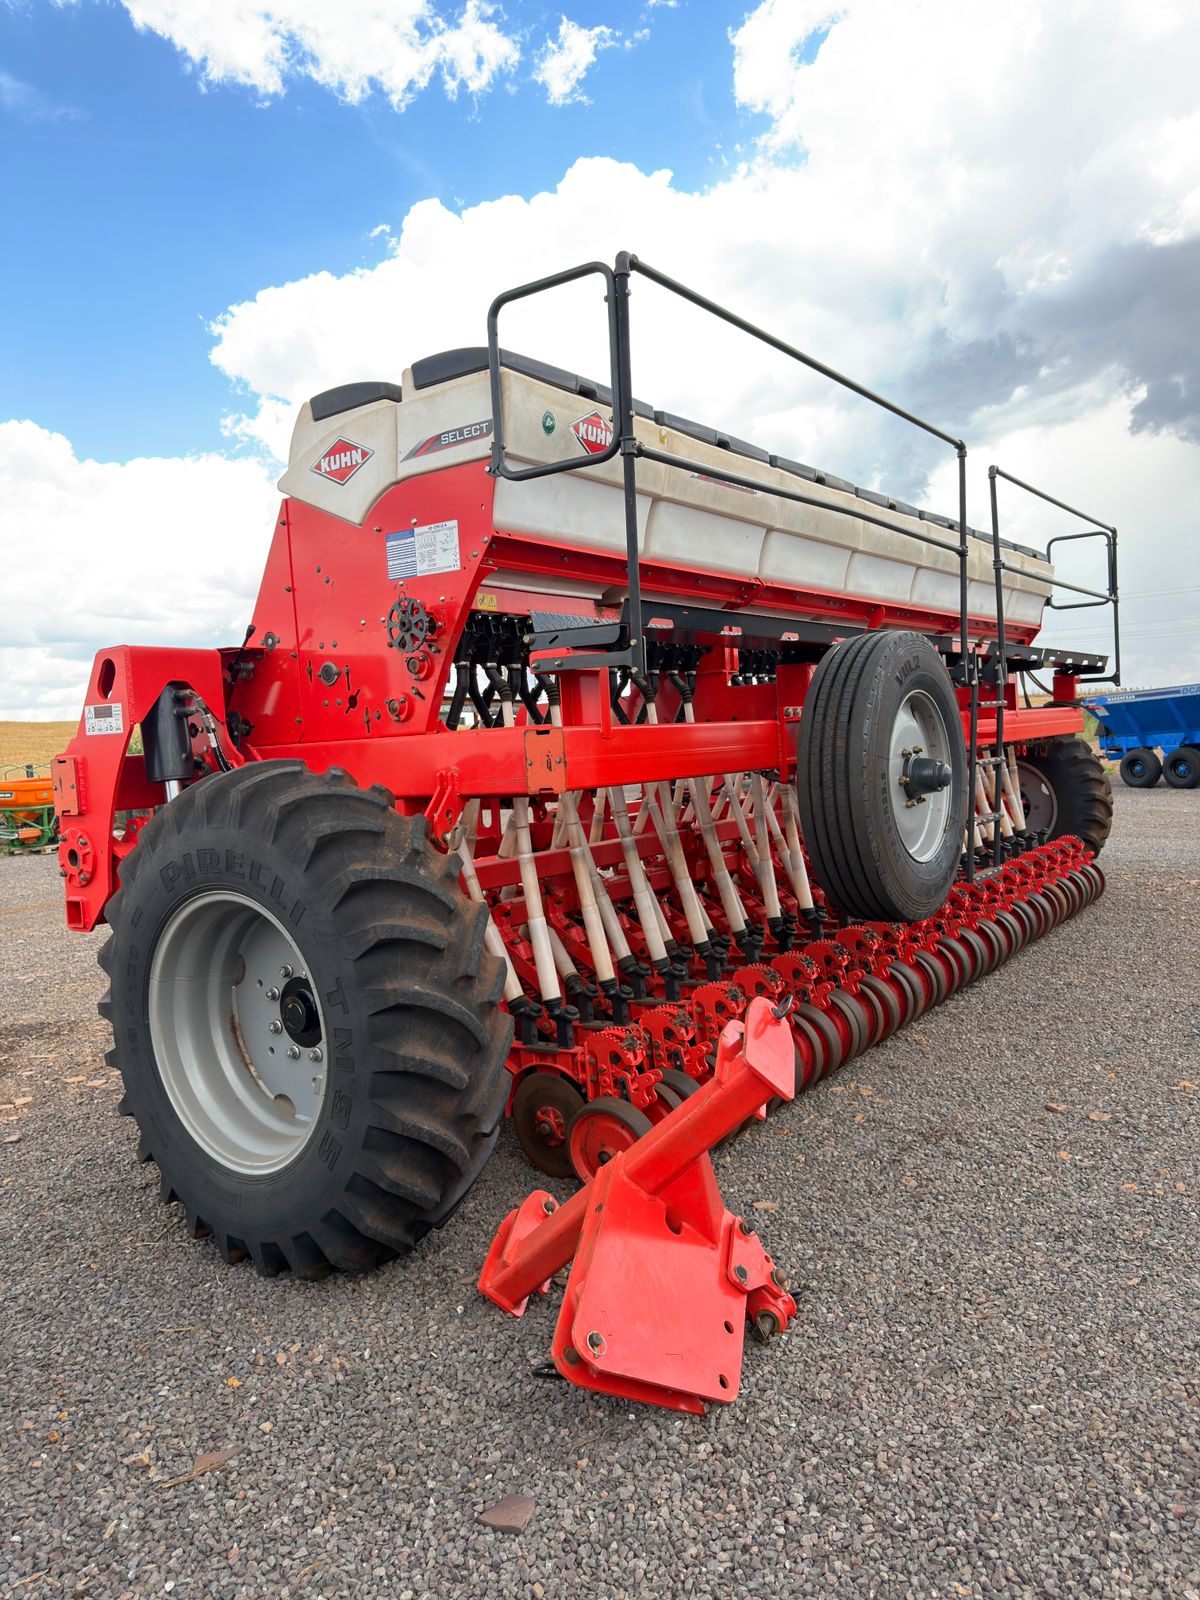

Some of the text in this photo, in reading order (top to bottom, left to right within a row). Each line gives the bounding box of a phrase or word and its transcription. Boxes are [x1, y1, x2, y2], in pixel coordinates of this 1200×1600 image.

[440, 422, 489, 444] SELECT
[579, 421, 614, 447] KUHN
[320, 448, 363, 473] KUHN
[159, 848, 306, 926] PIRELLI
